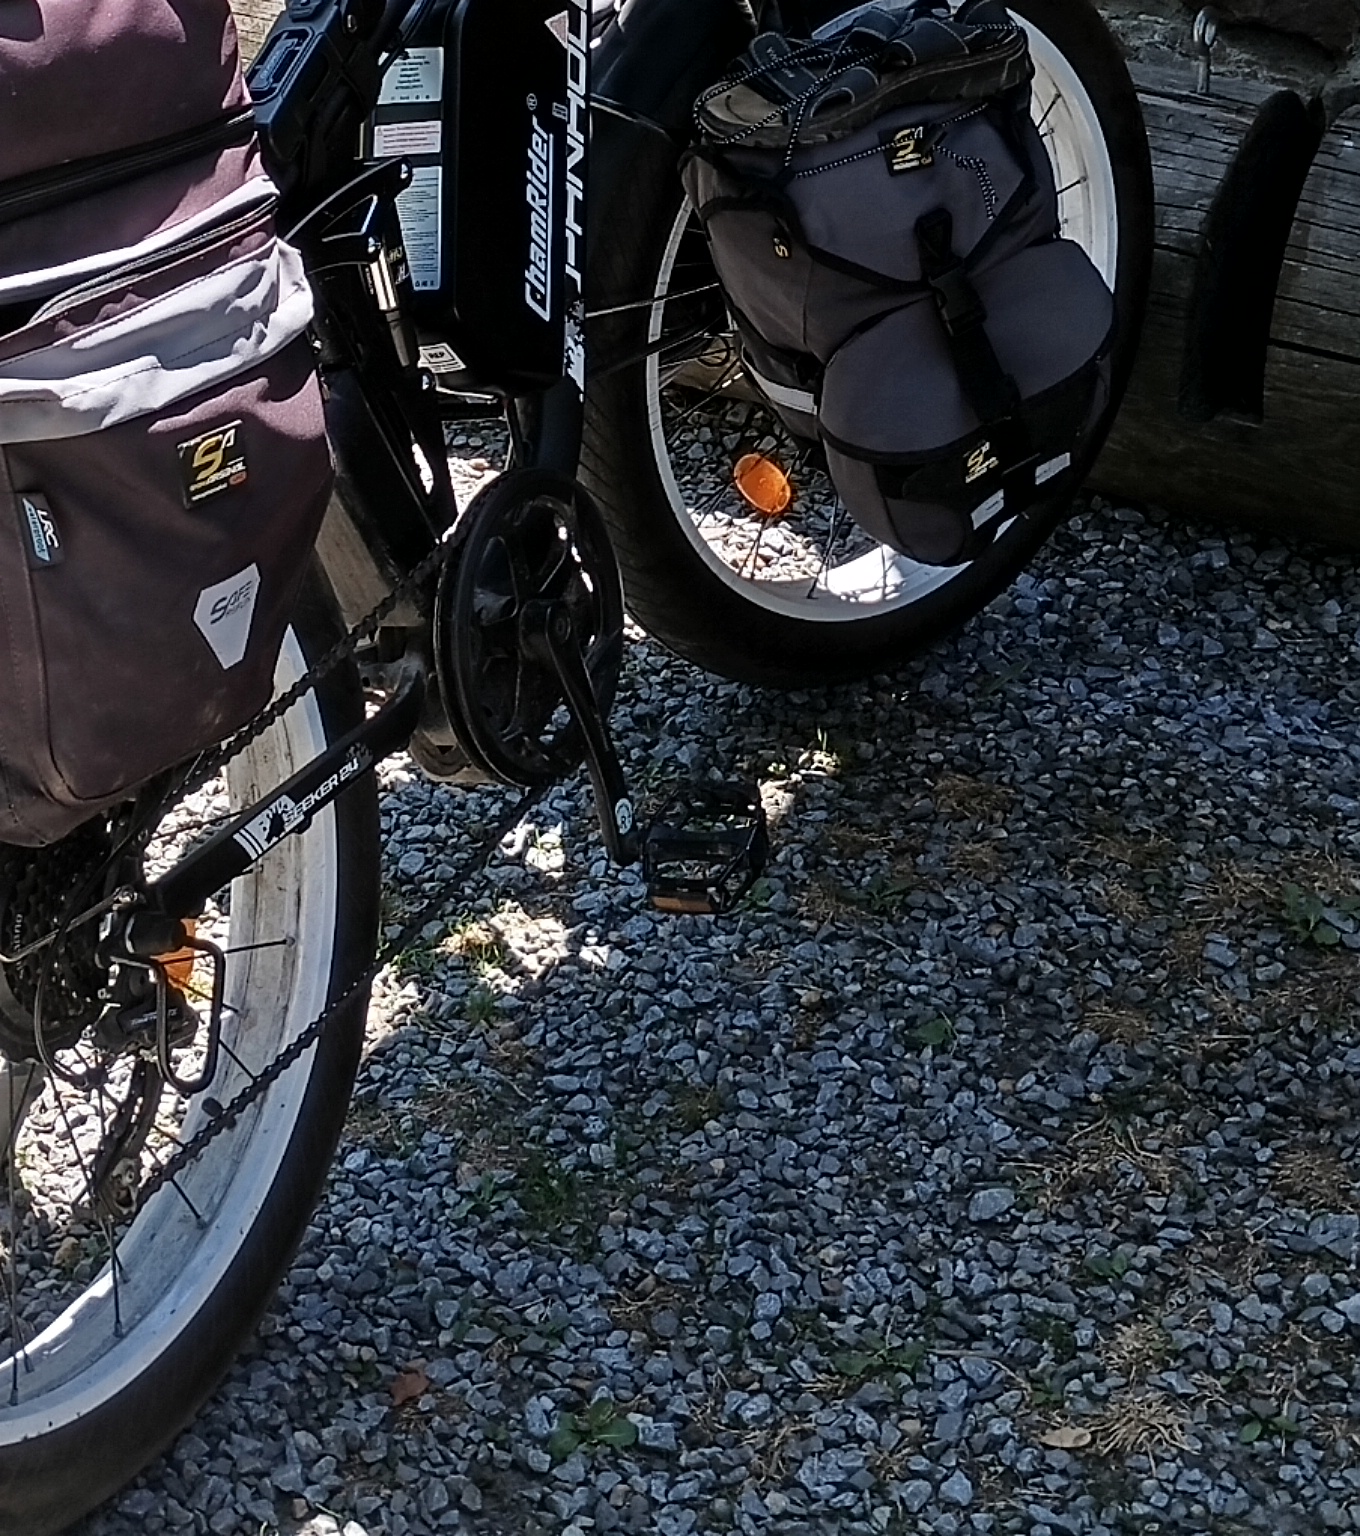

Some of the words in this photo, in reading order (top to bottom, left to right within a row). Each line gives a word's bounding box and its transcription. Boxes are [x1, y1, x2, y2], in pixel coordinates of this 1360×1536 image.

[525, 114, 552, 322] ChamRider
[37, 509, 60, 549] LRC
[210, 580, 253, 626] SAFE
[282, 773, 340, 825] SEEKER
